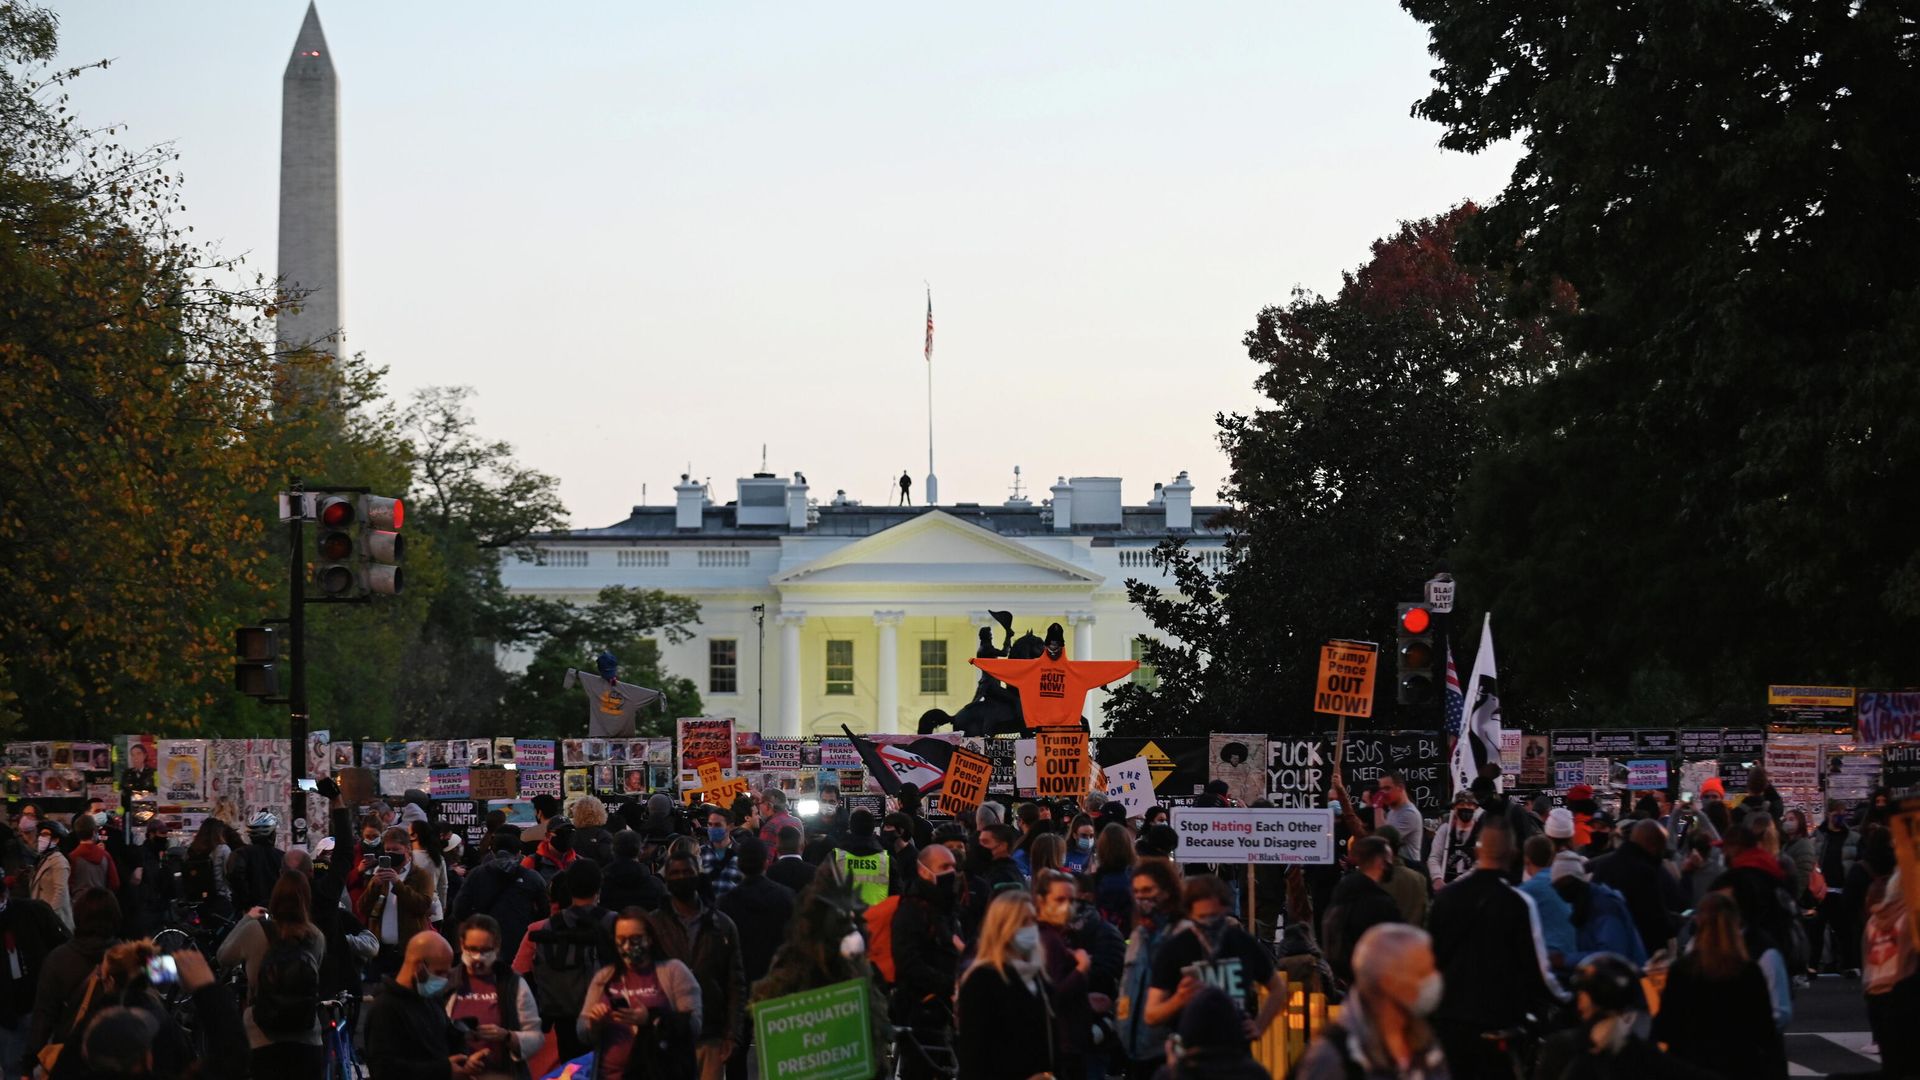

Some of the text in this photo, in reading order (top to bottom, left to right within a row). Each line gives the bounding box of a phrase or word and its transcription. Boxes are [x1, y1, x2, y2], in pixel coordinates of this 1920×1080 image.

[1327, 648, 1372, 664] Trump/
[1328, 661, 1366, 675] Pence
[1040, 672, 1066, 683] #OUT
[1328, 675, 1364, 694] OUT
[1040, 682, 1064, 692] NOW!
[1318, 692, 1368, 714] NOW!
[1042, 734, 1083, 746] Trump/
[169, 746, 198, 754] JUSTICE
[1044, 747, 1080, 756] Pence
[1268, 741, 1324, 766] FUCK
[955, 754, 988, 775] Trump/
[1046, 758, 1079, 774] OUT
[953, 767, 982, 784] Pence
[1119, 771, 1141, 780] THE
[1268, 768, 1322, 792] YOUR
[1556, 771, 1584, 782] LIES
[480, 780, 504, 788] LIVES
[951, 780, 979, 800] OUT
[1040, 777, 1086, 793] NOW!
[167, 792, 200, 800] BREONNA
[704, 782, 744, 802] ESUS
[441, 802, 473, 814] TRUMP
[450, 814, 476, 825] UNFIT
[1180, 820, 1322, 834] Stop Hating Each Other
[1186, 836, 1317, 850] Because You Disagree
[848, 859, 877, 870] PRESS
[1248, 853, 1320, 862] DCBlackTours.com
[767, 1000, 860, 1036] POTSQUATCH
[802, 1032, 828, 1048] For
[778, 1040, 860, 1076] PRESIDENT
